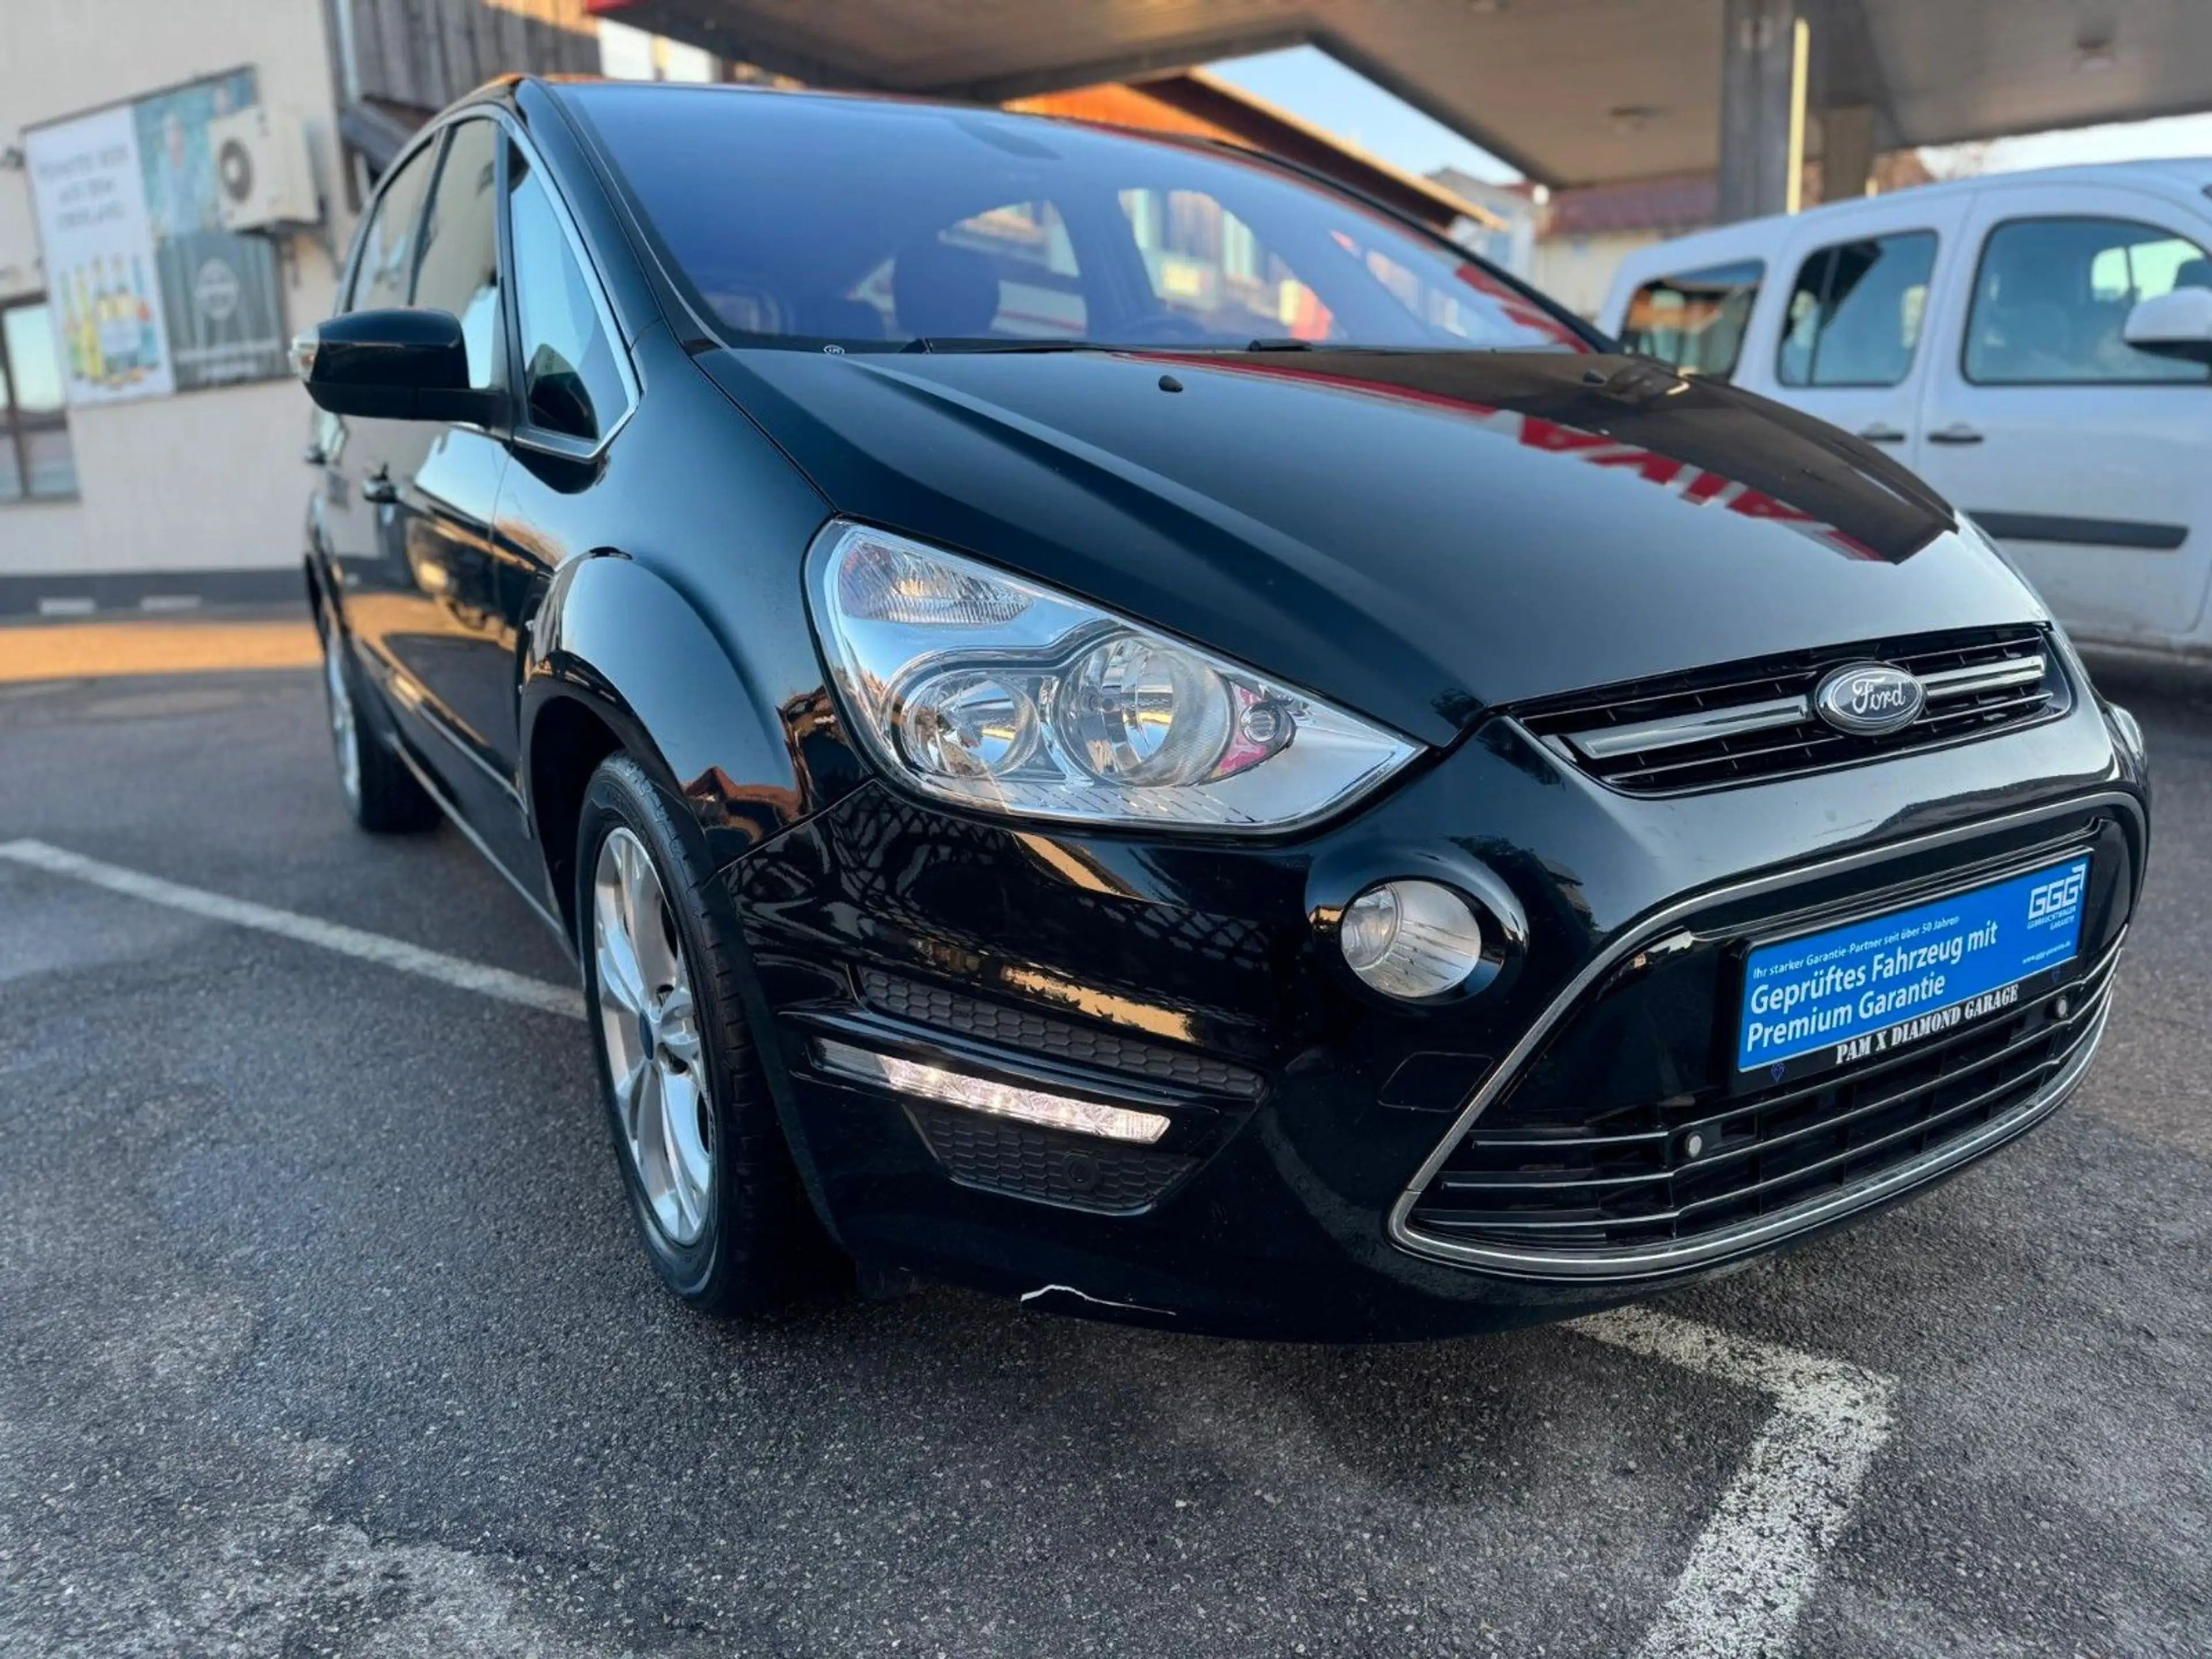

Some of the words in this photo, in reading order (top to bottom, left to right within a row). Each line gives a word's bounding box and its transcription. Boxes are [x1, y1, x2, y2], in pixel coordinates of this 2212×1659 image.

[1852, 677, 1906, 714] Ford
[2028, 874, 2081, 920] GGG
[1751, 965, 1866, 1014] Geprüftes
[1872, 936, 1963, 982] Fahrzeug
[1967, 920, 1998, 952] mit
[1753, 966, 1767, 979] Ihr
[1769, 959, 1804, 975] starker
[1806, 938, 1883, 966] Garantie-Partner
[1884, 931, 1900, 945] seit
[1901, 926, 1920, 940] über
[1921, 922, 1932, 934] 50
[1932, 916, 1960, 931] Jahren
[1747, 1004, 1853, 1052] Premium
[1858, 971, 1945, 1019] Garantie
[1836, 1036, 1872, 1065] PAM
[1874, 1032, 1887, 1051] X
[1891, 1006, 1961, 1046] DIAMOND
[1964, 984, 2019, 1020] GARAGE
